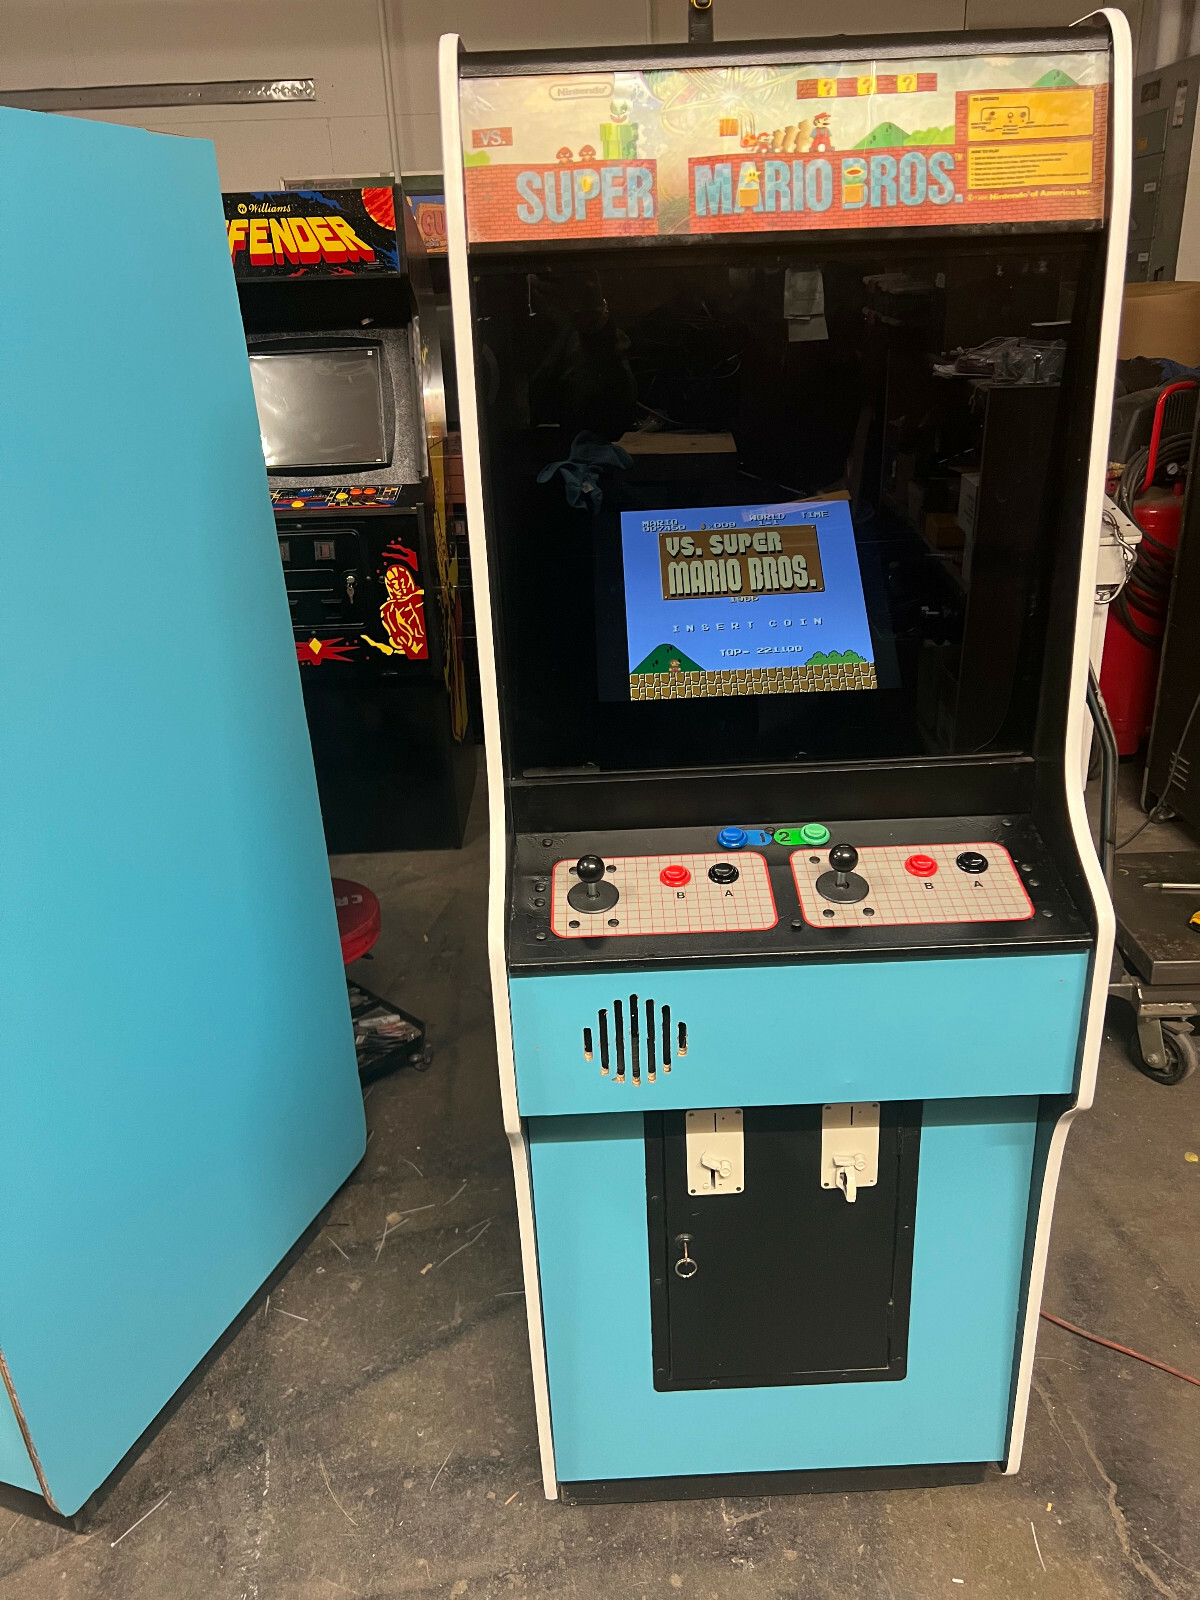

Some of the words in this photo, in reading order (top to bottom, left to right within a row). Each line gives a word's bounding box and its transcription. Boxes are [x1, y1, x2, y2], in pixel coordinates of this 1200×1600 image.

[557, 86, 607, 97] Nintendo
[480, 129, 507, 146] VS.
[517, 168, 654, 223] SUPER
[695, 160, 833, 217] MARIO
[842, 151, 963, 209] BROS.
[248, 203, 291, 214] Williams
[226, 216, 375, 265] FENDER
[749, 513, 786, 521] WORLD
[802, 511, 830, 519] TIME
[642, 519, 678, 527] MARIO
[665, 537, 703, 557] VS.
[710, 532, 783, 555] SUPER
[668, 558, 742, 596] MARIO
[748, 554, 817, 590] BROS.
[672, 621, 755, 634] INSERT
[769, 617, 824, 628] COIN
[757, 645, 804, 655] 221100
[759, 832, 766, 843] 1
[778, 831, 792, 842] 2
[924, 882, 934, 890] B
[973, 880, 983, 888] A
[676, 891, 686, 899] B
[725, 889, 734, 898] A
